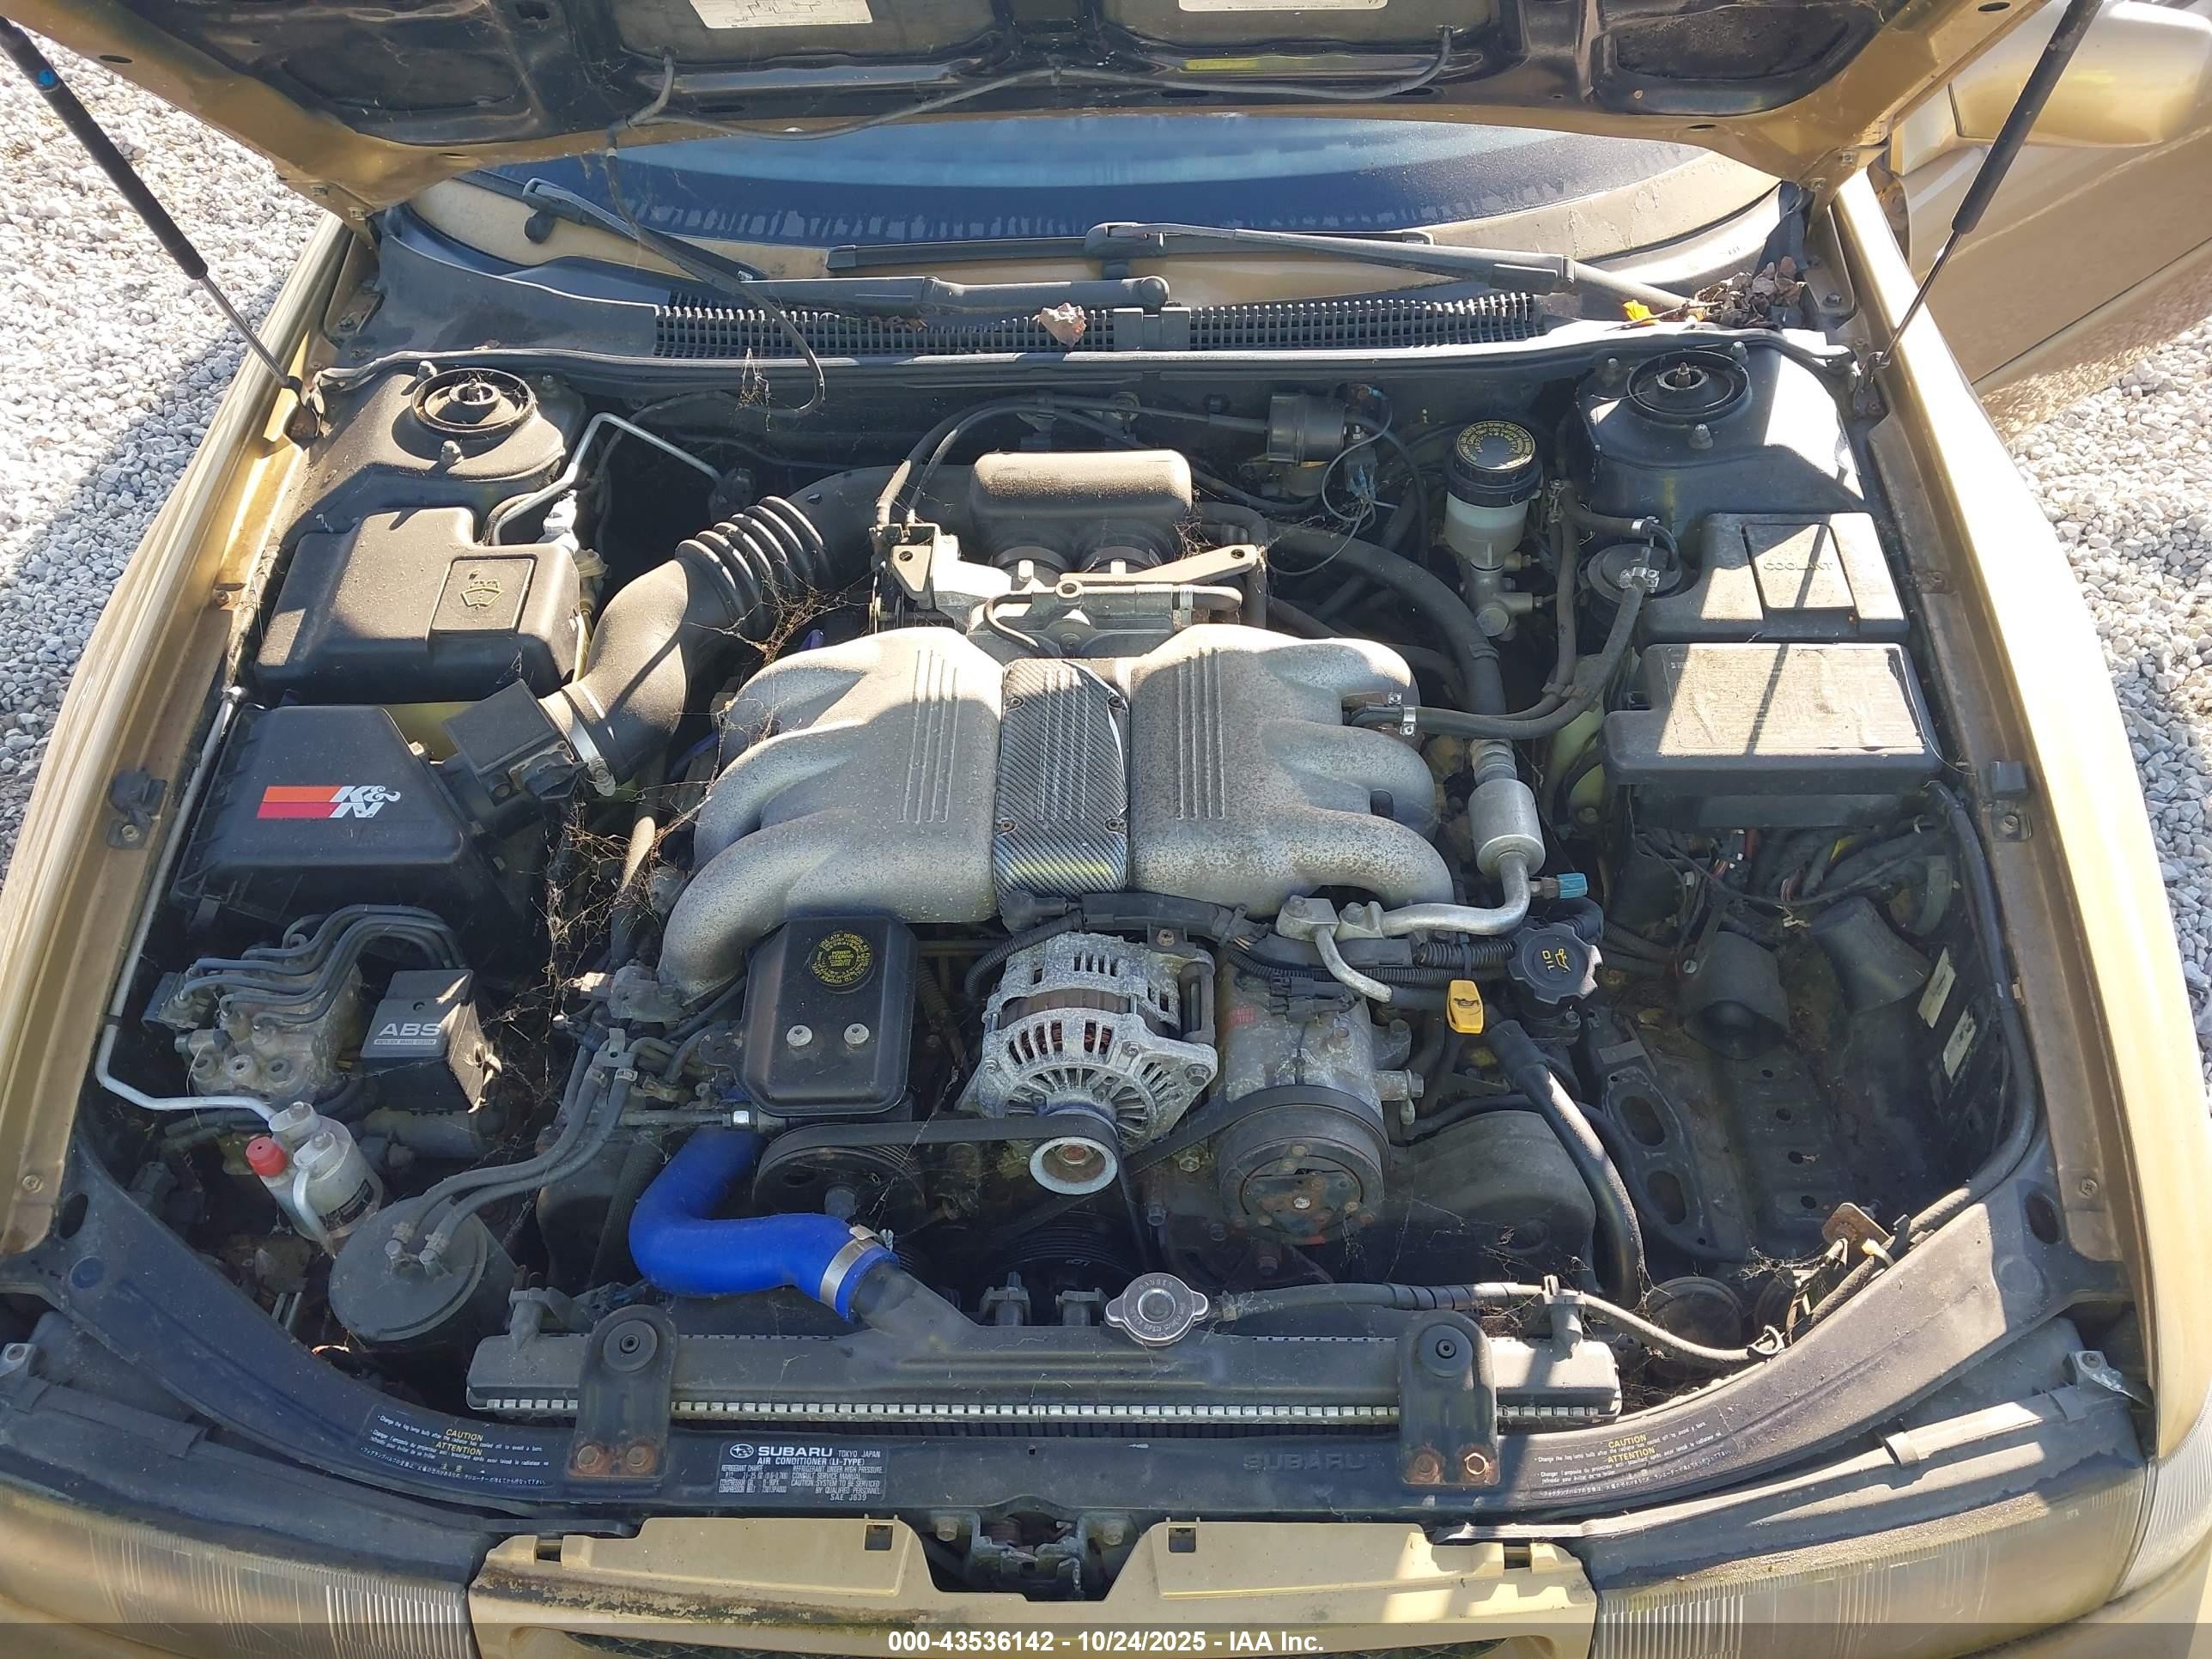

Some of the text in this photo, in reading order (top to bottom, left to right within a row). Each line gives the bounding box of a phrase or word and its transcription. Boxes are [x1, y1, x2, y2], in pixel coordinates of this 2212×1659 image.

[1764, 562, 1832, 571] COOLANT
[329, 786, 401, 818] K&N
[1542, 950, 1555, 970] OIL
[378, 1023, 441, 1036] ABS
[446, 1429, 483, 1442] CAUTION
[1608, 1434, 1647, 1449] CAUTION
[435, 1441, 483, 1456] ATTENTION
[757, 1446, 833, 1457] SUBARU
[838, 1449, 858, 1458] TOKYO
[1607, 1448, 1656, 1463] ATTENTION
[775, 1457, 827, 1466] CONDITIONER
[829, 1457, 866, 1466] (LI-TYPE)
[1243, 1453, 1368, 1471] SUBARU
